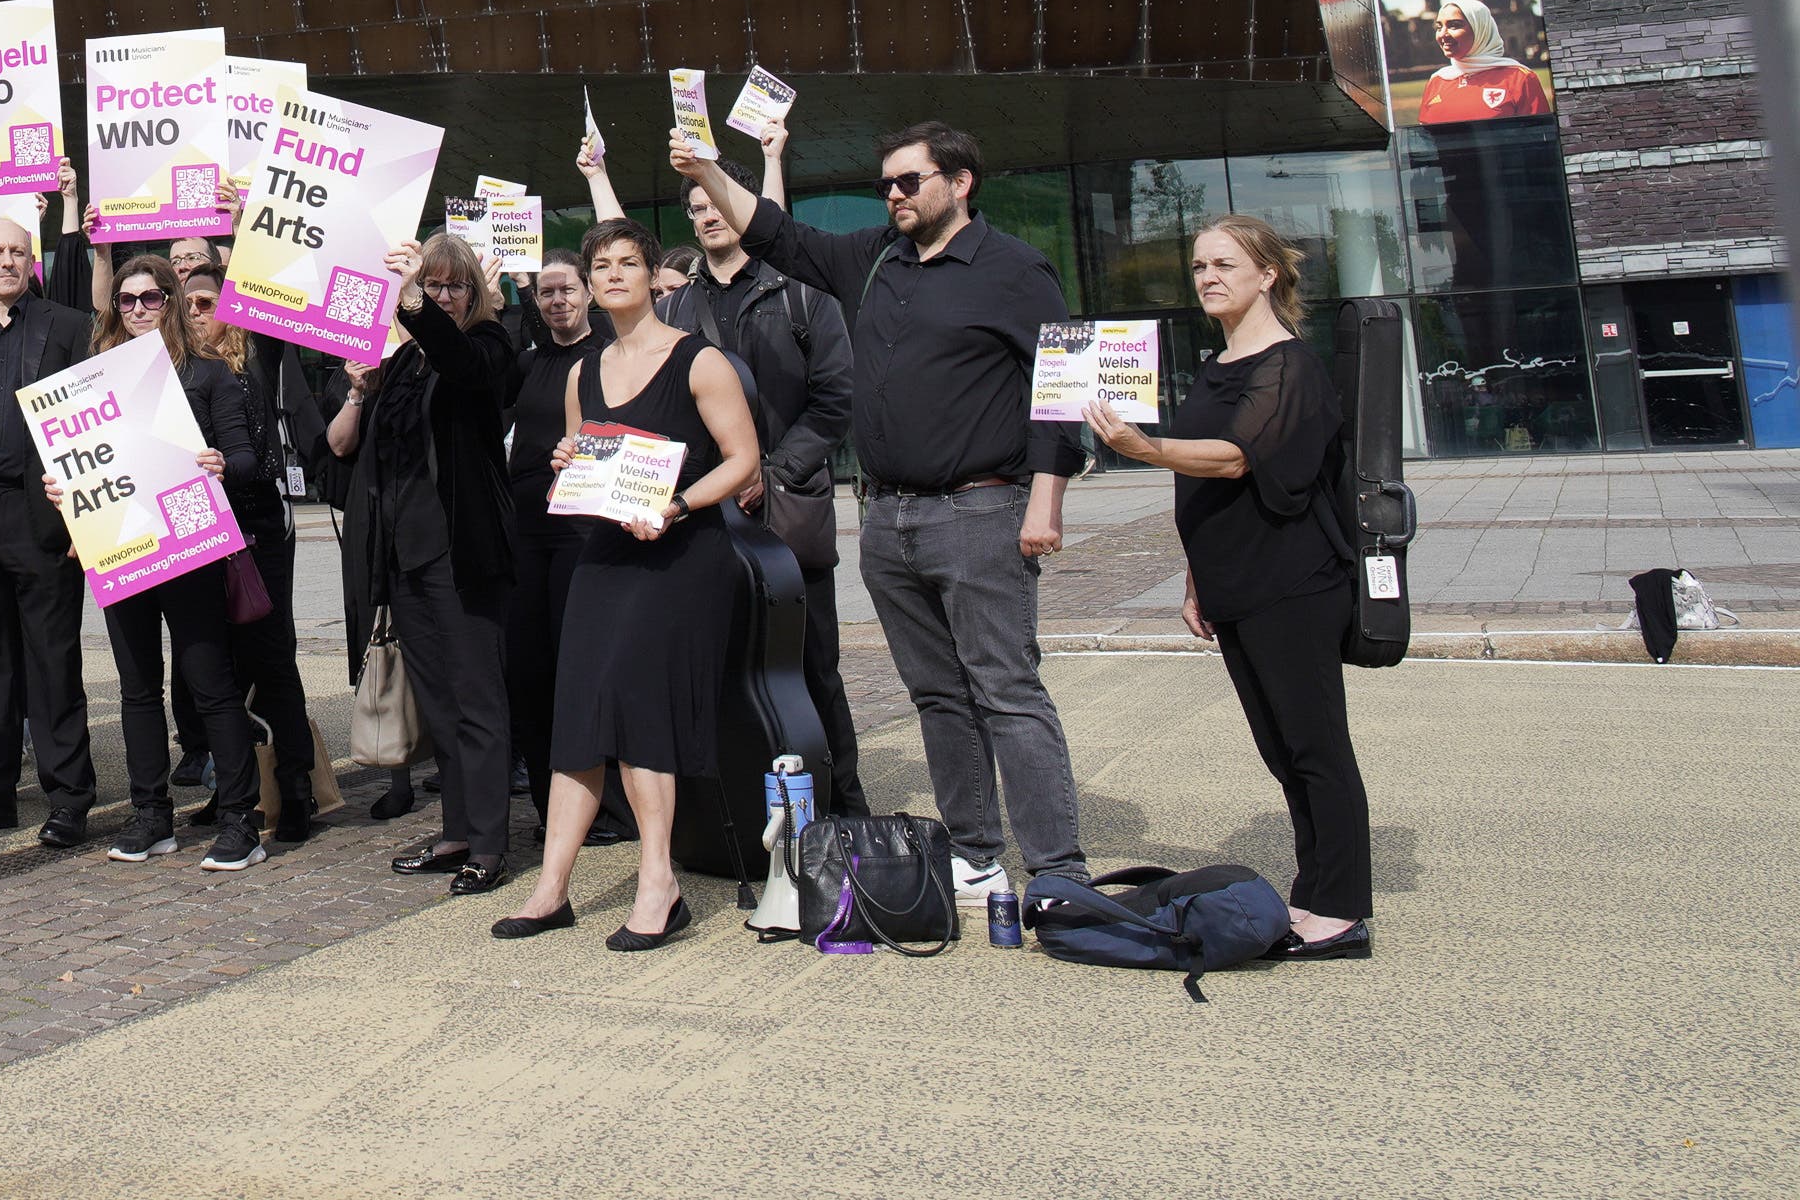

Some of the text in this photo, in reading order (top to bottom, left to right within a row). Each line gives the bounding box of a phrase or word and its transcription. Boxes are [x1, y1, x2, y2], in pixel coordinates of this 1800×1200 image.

[96, 77, 217, 112] Protect
[673, 87, 698, 100] Protect
[227, 93, 274, 114] rote
[675, 100, 696, 113] Welsh
[326, 120, 351, 134] Union
[678, 114, 706, 128] National
[96, 118, 180, 150] WNO
[272, 127, 365, 177] Fund
[266, 165, 328, 208] The
[104, 201, 156, 212] #WNOProud
[491, 211, 532, 221] Protect
[115, 217, 221, 232] themu.org/ProtectWNO
[250, 206, 325, 249] Arts
[492, 223, 527, 233] Welsh
[492, 235, 538, 245] National
[493, 247, 527, 258] Opera
[242, 280, 304, 306] #WNOProud
[248, 305, 372, 352] themu.org/ProtectWNO
[1100, 340, 1147, 352] Protect
[1039, 359, 1067, 368] Diogelu
[1099, 357, 1139, 369] Welsh
[1038, 370, 1061, 378] Opera
[1098, 373, 1152, 385] National
[70, 383, 93, 398] Union
[1037, 380, 1088, 389] Cenedlaethol
[1036, 391, 1061, 400] Cymru
[1097, 388, 1137, 402] Opera
[40, 391, 122, 447] Fund
[52, 441, 115, 481] The
[624, 450, 671, 468] Protect
[620, 463, 659, 480] Welsh
[614, 477, 670, 497] National
[71, 474, 136, 519] Arts
[611, 490, 651, 507] Opera
[98, 538, 154, 568] #WNOProud
[118, 532, 230, 587] themu.org/ProtectWNO
